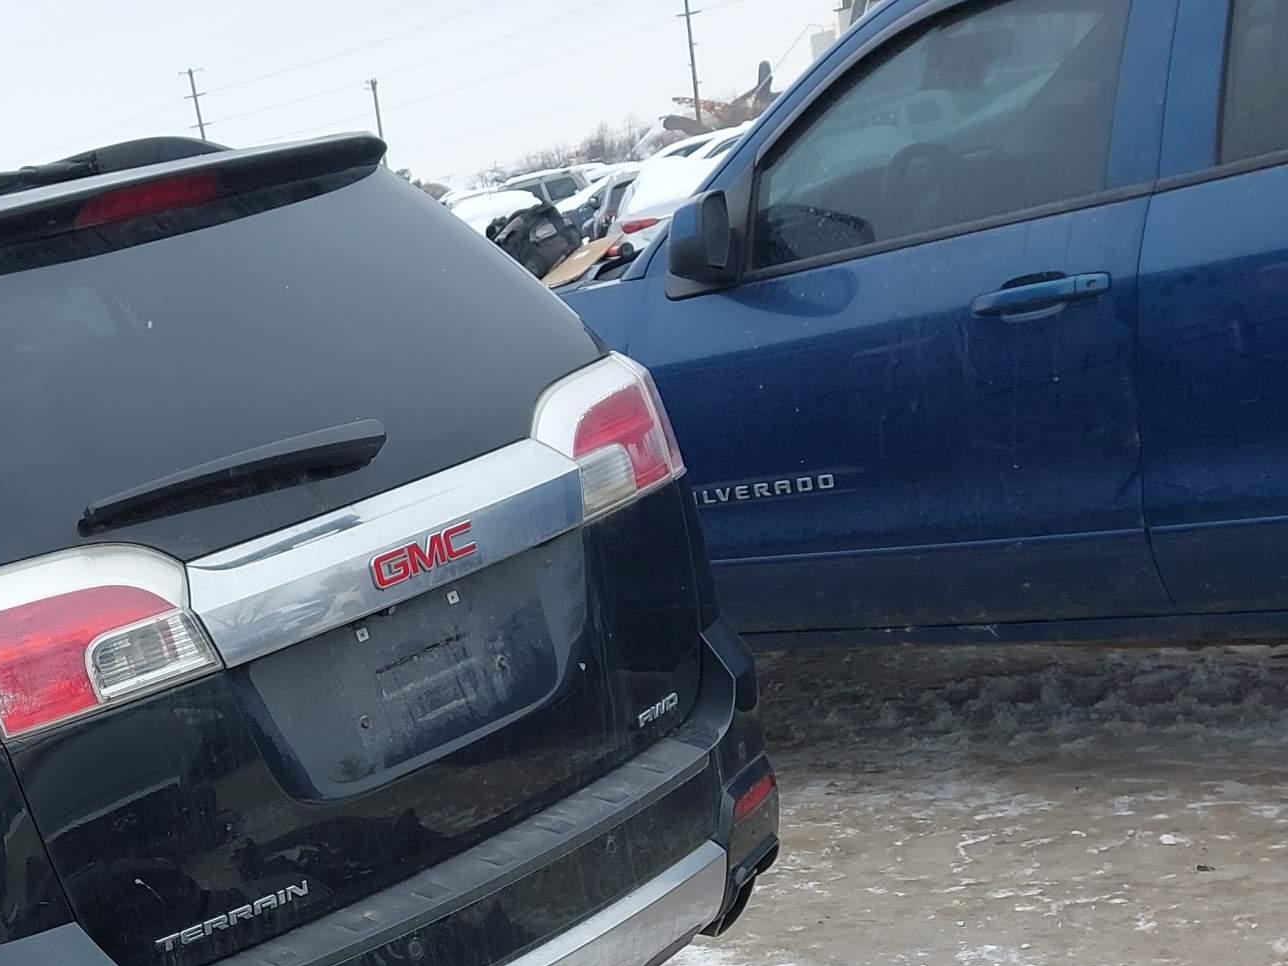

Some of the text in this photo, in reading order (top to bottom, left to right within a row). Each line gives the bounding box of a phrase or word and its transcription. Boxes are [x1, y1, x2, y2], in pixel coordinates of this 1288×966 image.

[693, 473, 835, 506] ILVERADO
[370, 519, 477, 591] GMC
[638, 692, 680, 728] AWD
[155, 879, 309, 952] TERRAIN
